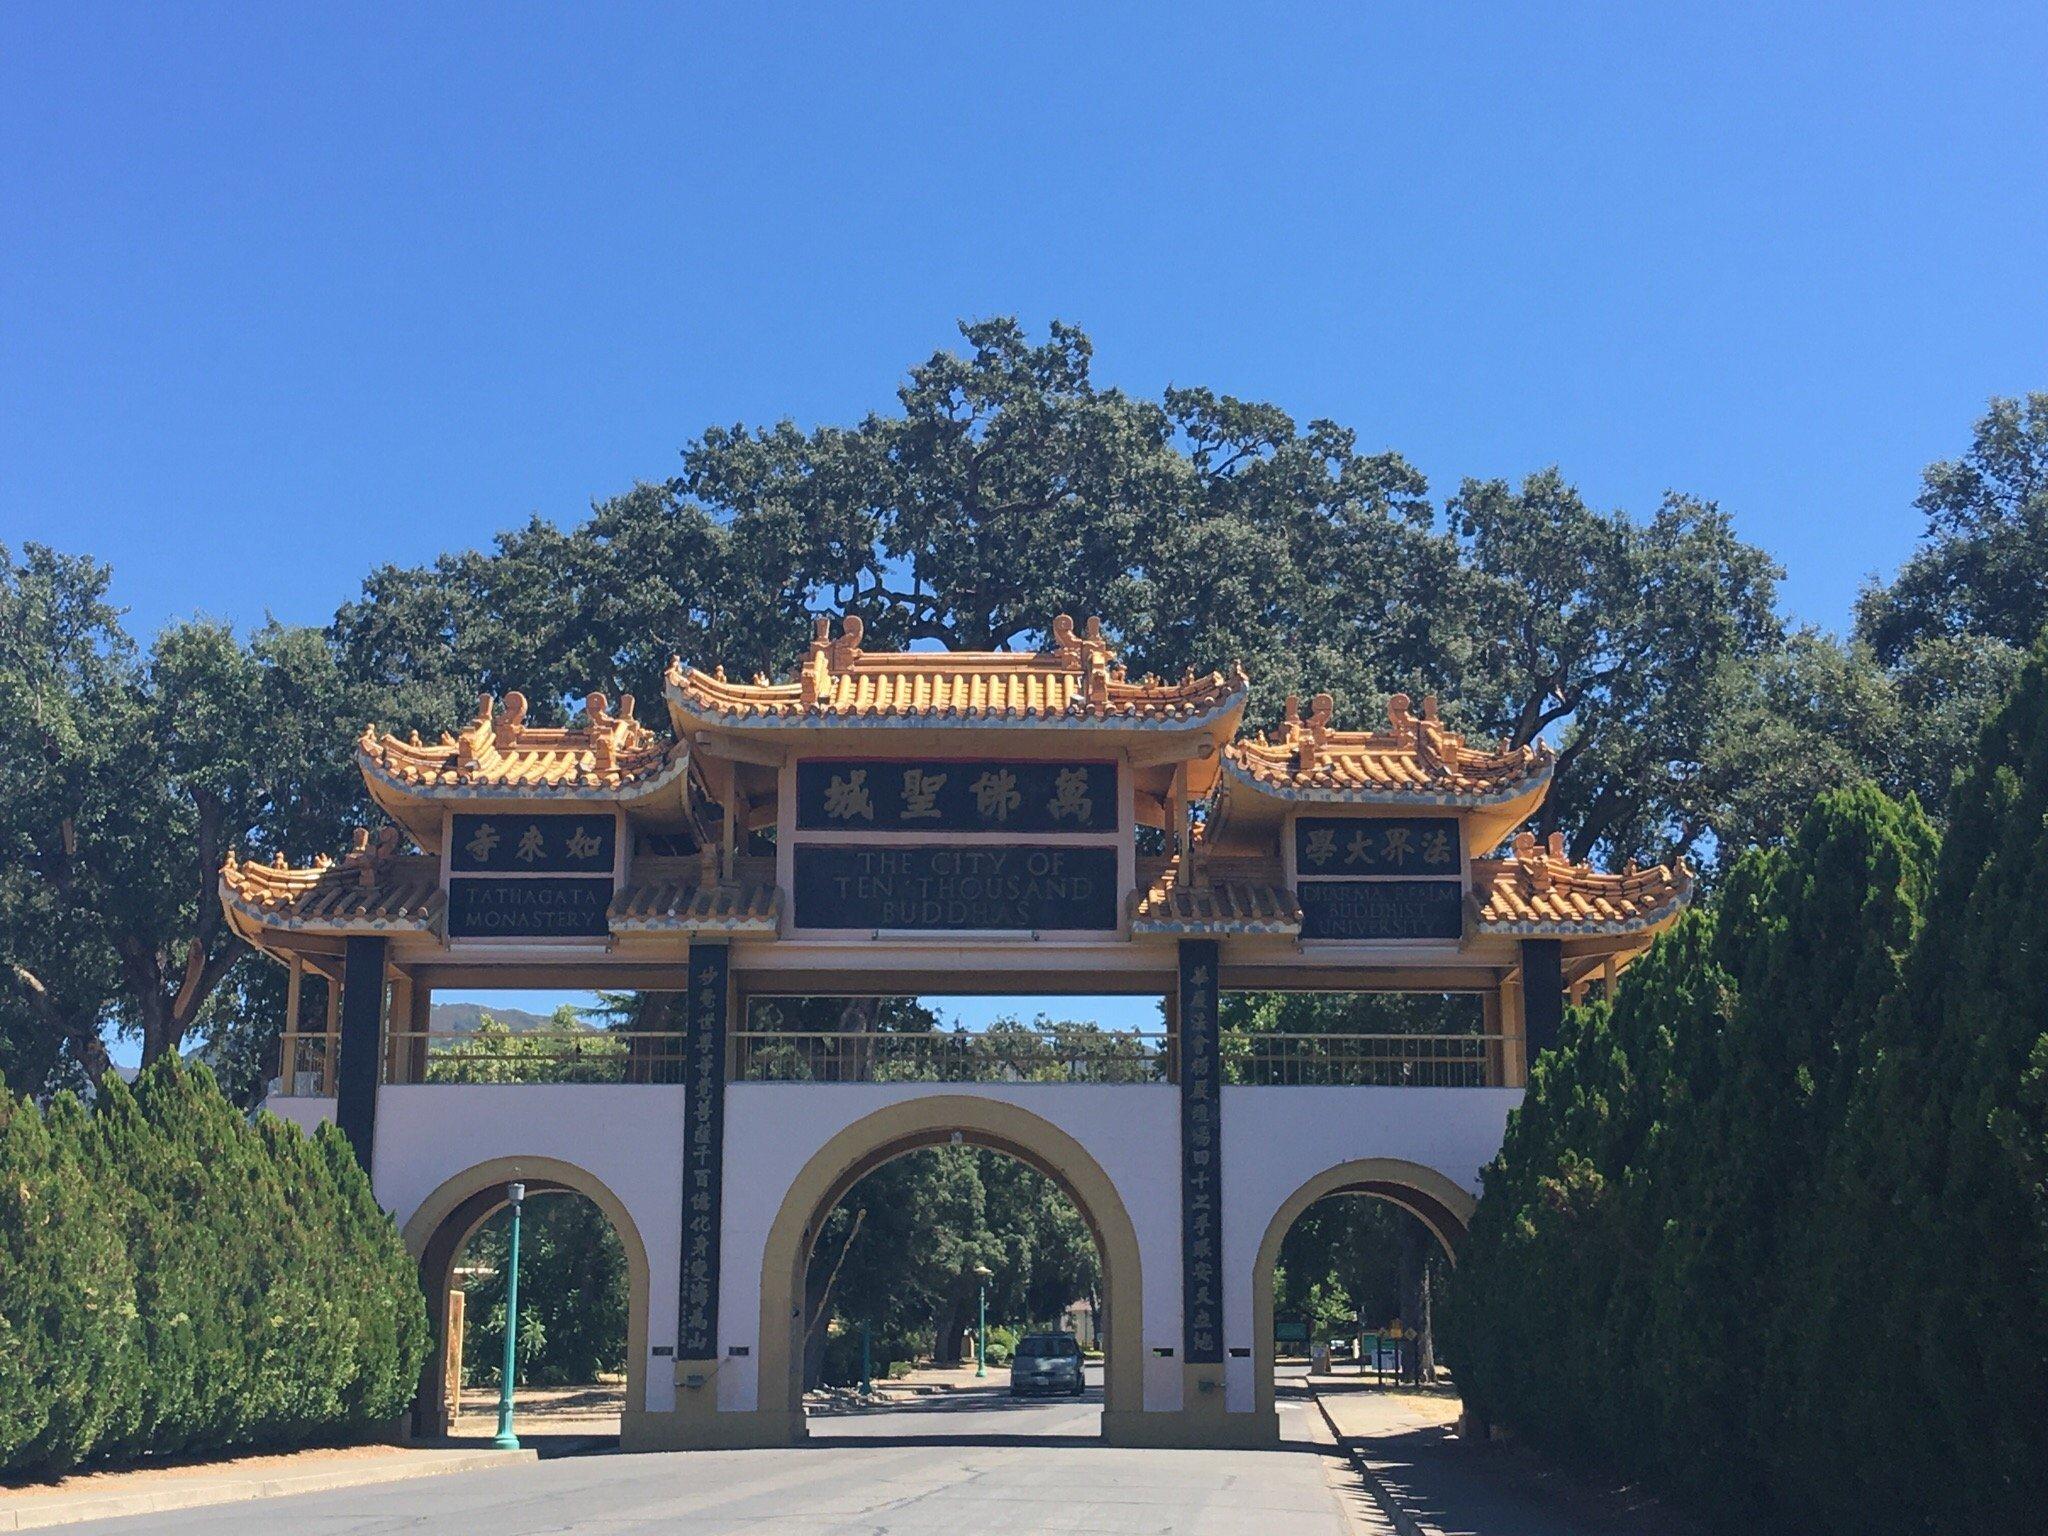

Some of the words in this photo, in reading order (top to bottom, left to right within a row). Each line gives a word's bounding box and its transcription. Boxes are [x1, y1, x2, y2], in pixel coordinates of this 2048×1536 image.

[823, 767, 1093, 823] 萬佛聖城
[856, 852, 912, 874] THE
[930, 852, 1007, 875] CITY
[1027, 852, 1064, 875] OF
[465, 887, 597, 905] TATHAGATA
[834, 877, 893, 899] TEN
[918, 877, 1092, 900] THOUSAND
[465, 910, 596, 928] MONASTERY
[882, 901, 1030, 925] BUDDHAS
[1328, 902, 1427, 918] BUDDHIST
[1319, 919, 1435, 936] UNIVERSITY
